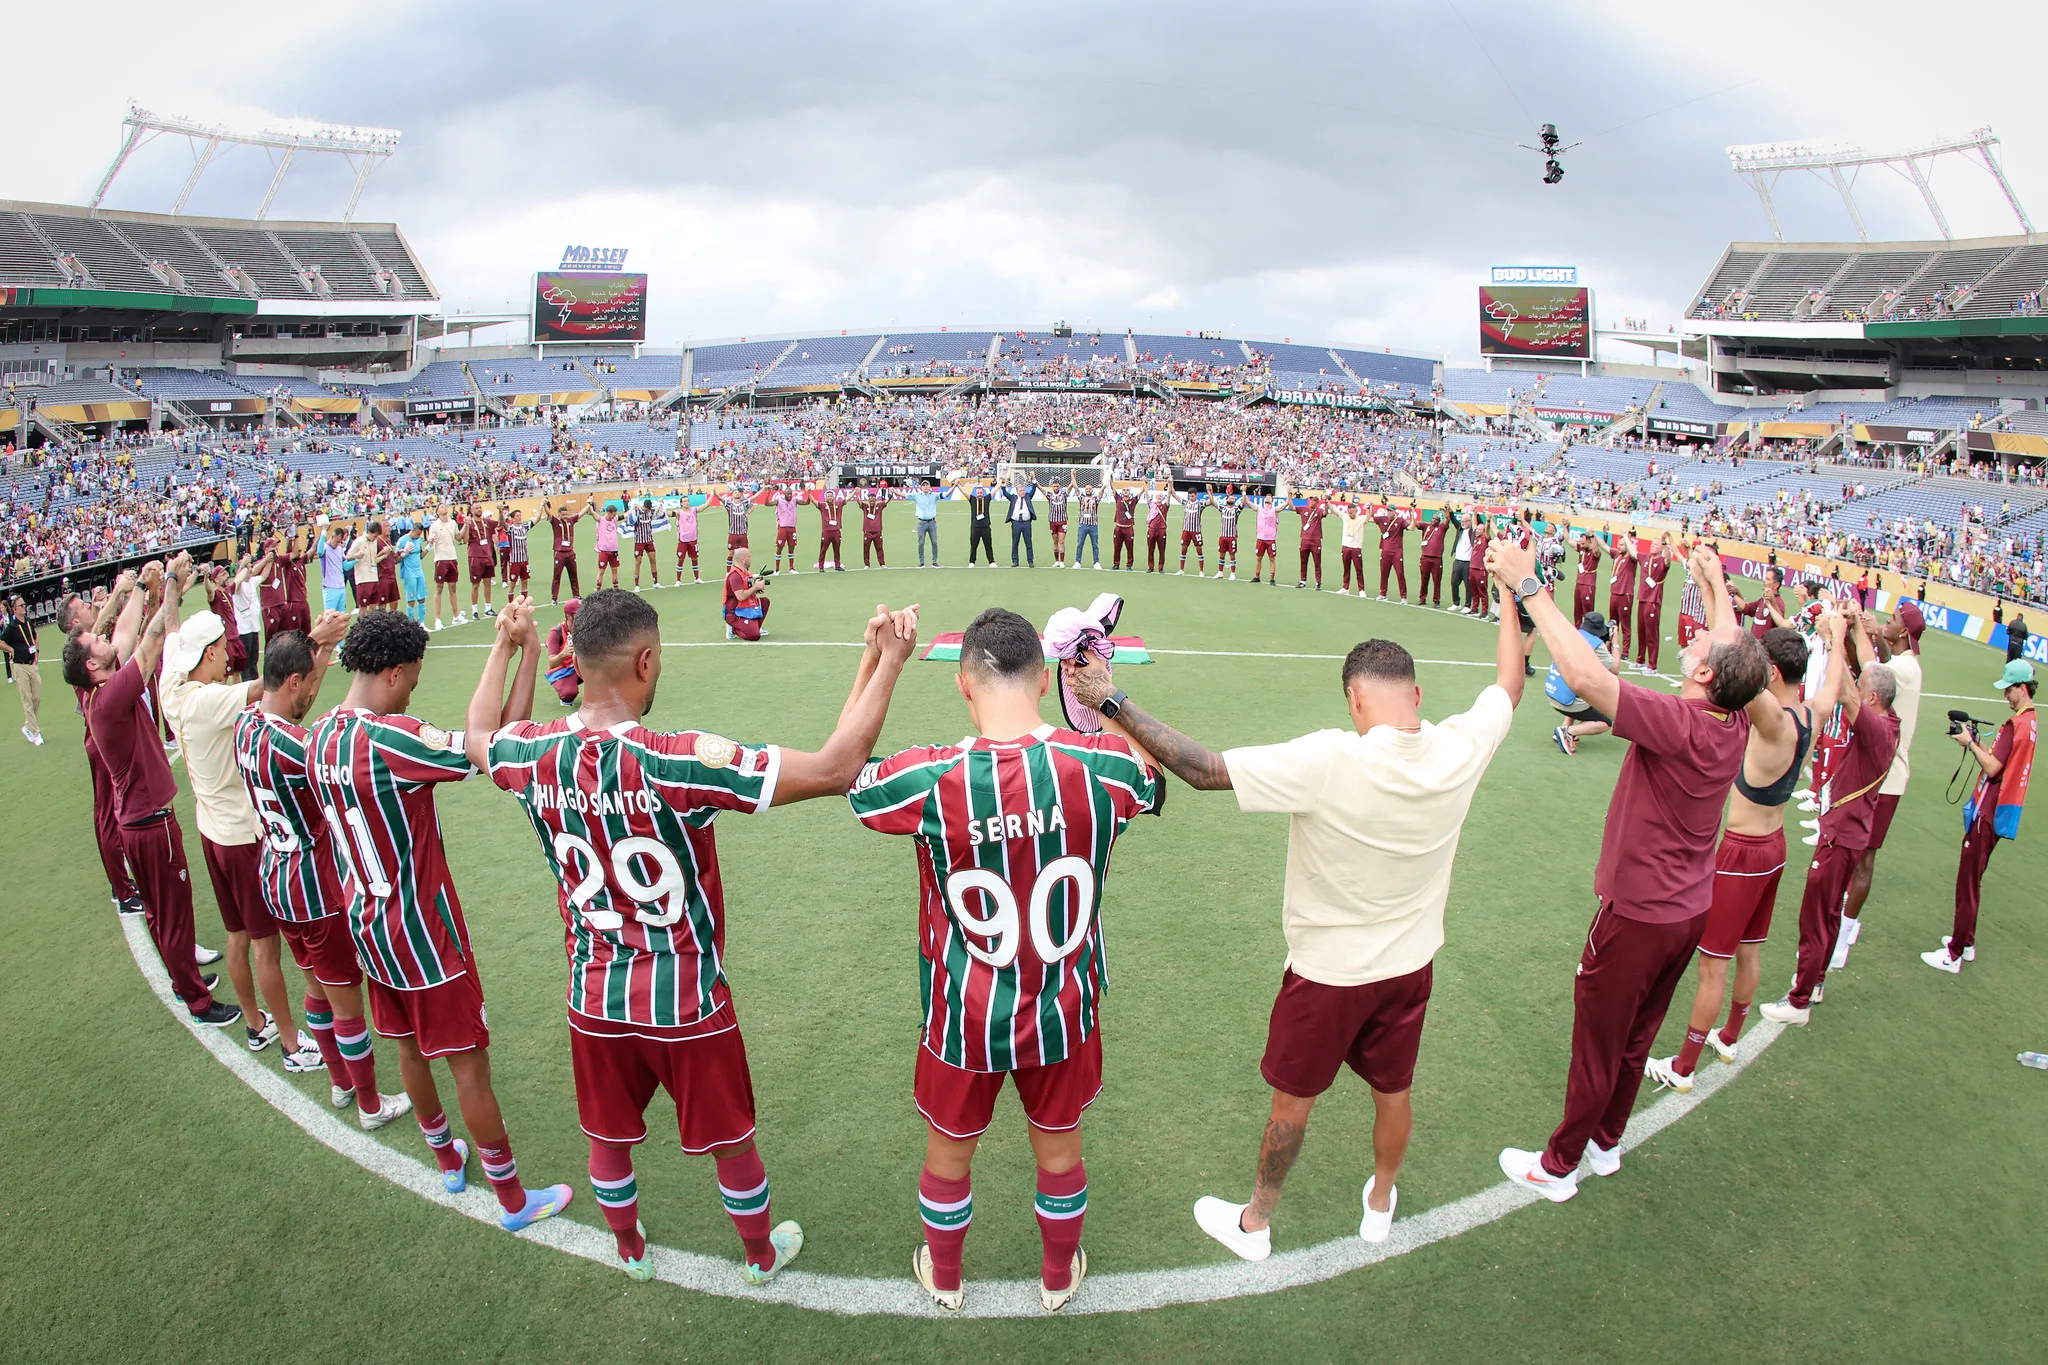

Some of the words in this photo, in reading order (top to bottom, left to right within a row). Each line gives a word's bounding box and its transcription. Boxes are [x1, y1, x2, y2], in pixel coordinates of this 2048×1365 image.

[562, 245, 628, 262] MASSEY
[1494, 268, 1527, 281] BUD
[1528, 268, 1574, 282] LIGHT
[415, 403, 428, 412] Take
[441, 401, 452, 409] The
[452, 400, 470, 409] World
[1337, 394, 1372, 408] 1952
[1537, 410, 1559, 420] NEW
[1559, 412, 1582, 421] YORK
[856, 466, 874, 475] Take
[874, 466, 881, 475] It
[882, 466, 890, 475] To
[892, 466, 907, 475] The
[907, 465, 930, 475] World
[1741, 560, 1786, 586] QATR
[316, 764, 350, 786] KENO
[532, 782, 589, 813] THIAGO
[590, 789, 662, 817] SANTOS
[967, 804, 1068, 846] SERNA
[324, 804, 392, 898] 11
[553, 831, 687, 930] 29
[945, 855, 1097, 969] 90
